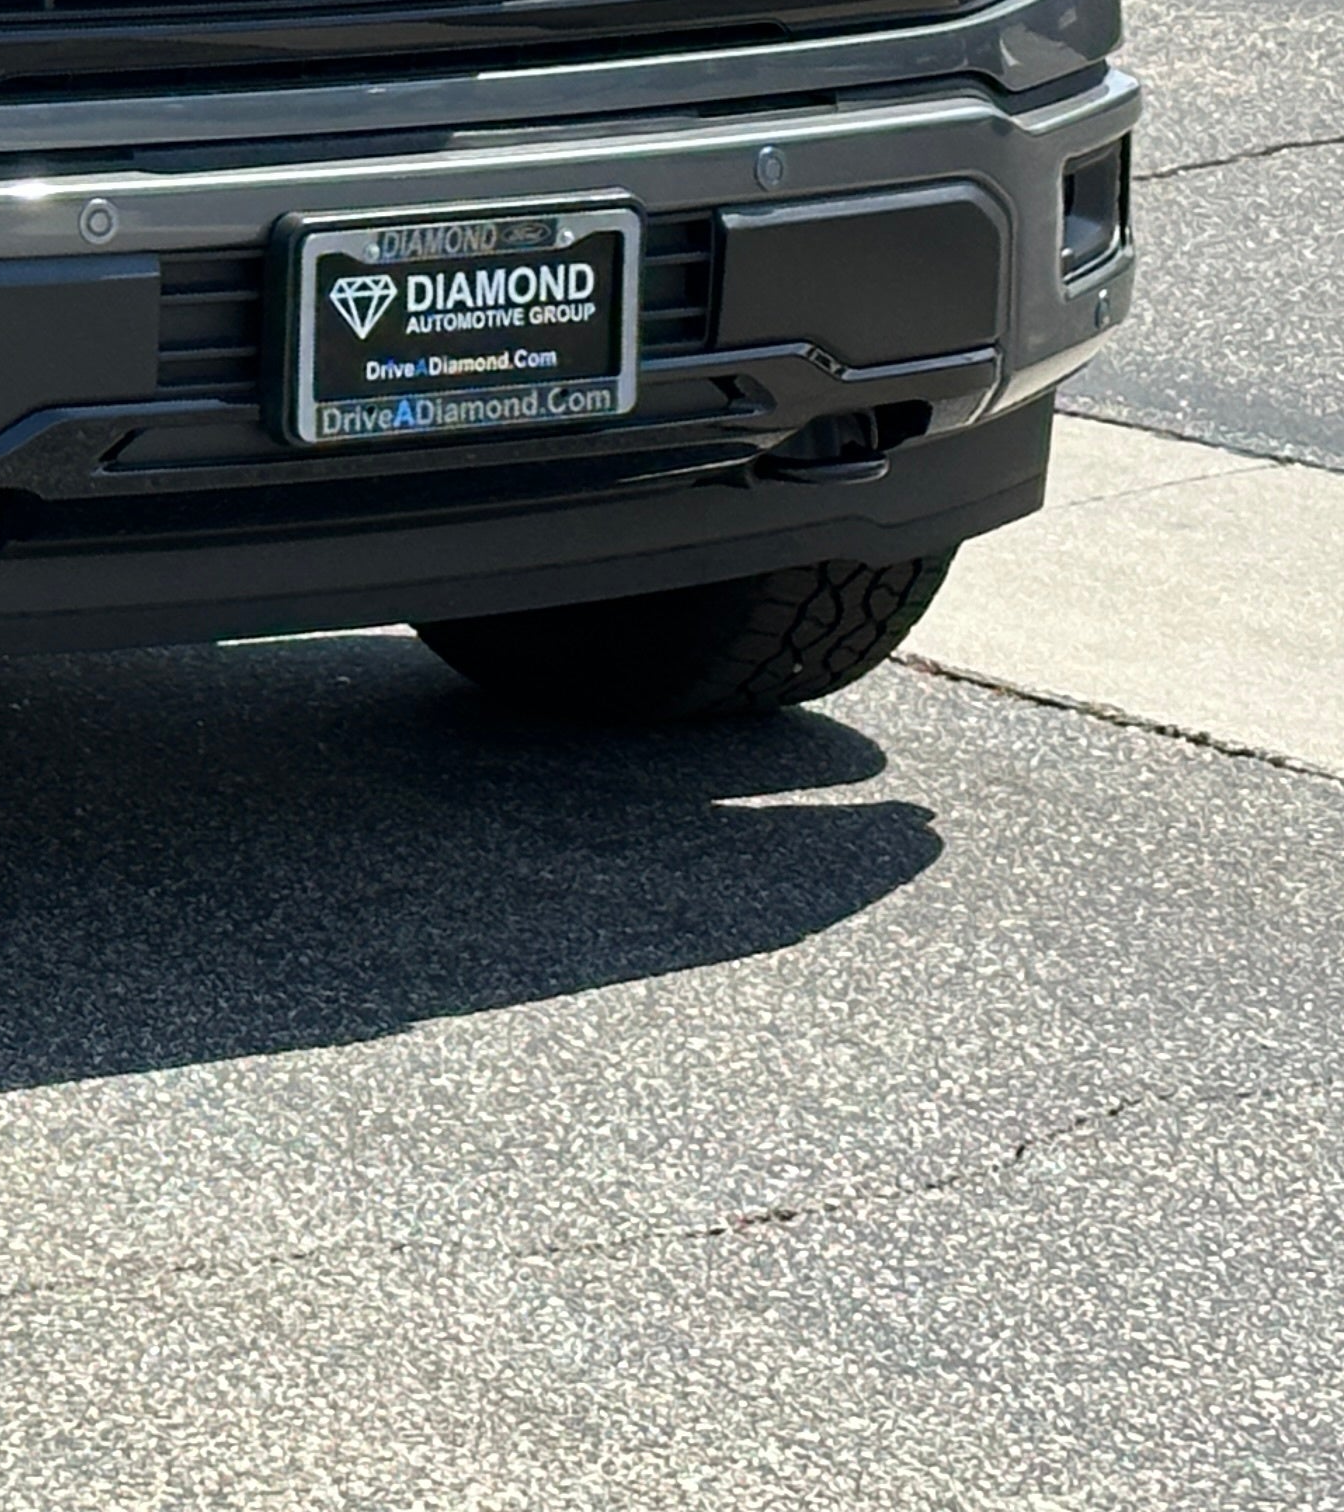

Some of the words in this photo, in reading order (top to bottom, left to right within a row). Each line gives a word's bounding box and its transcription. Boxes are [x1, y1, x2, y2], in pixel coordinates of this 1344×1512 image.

[381, 224, 498, 259] DIAMOND
[406, 263, 595, 313] DIAMOND
[405, 307, 525, 336] AUTOMOTIVE
[527, 303, 596, 326] GROUP
[365, 348, 558, 381] DriveADiamond.Com
[321, 386, 612, 435] DriveADiamond.Com
